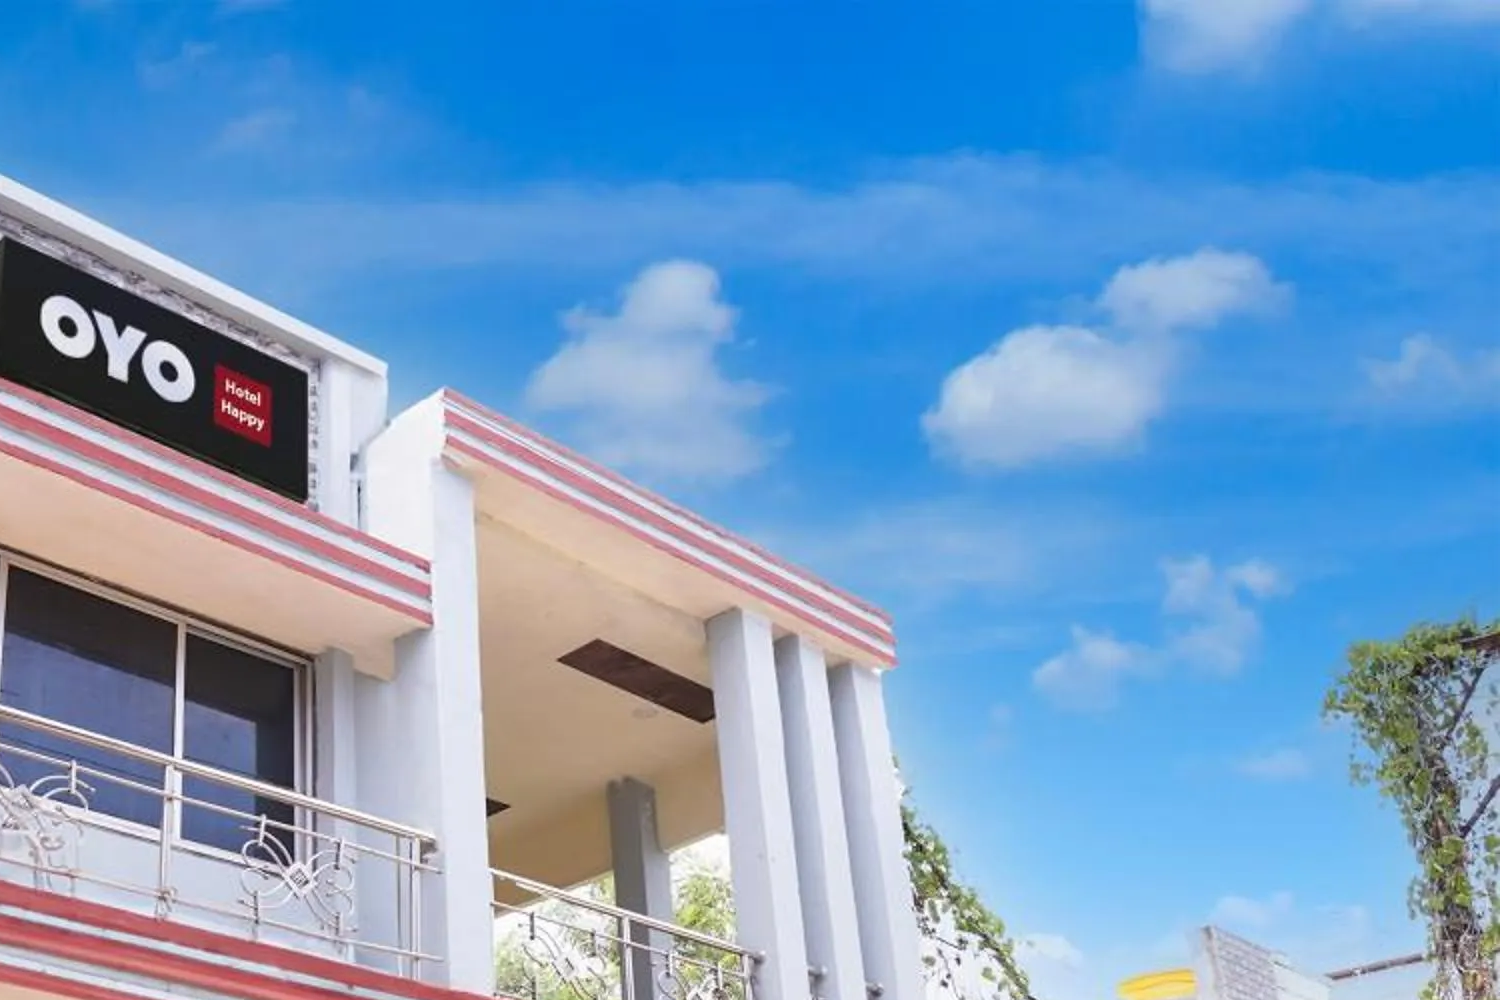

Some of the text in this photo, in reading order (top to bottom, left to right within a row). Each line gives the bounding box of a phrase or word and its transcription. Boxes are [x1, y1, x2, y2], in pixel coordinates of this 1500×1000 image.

[40, 295, 196, 403] OYO
[225, 378, 261, 406] Hotel
[221, 400, 265, 432] Happy
